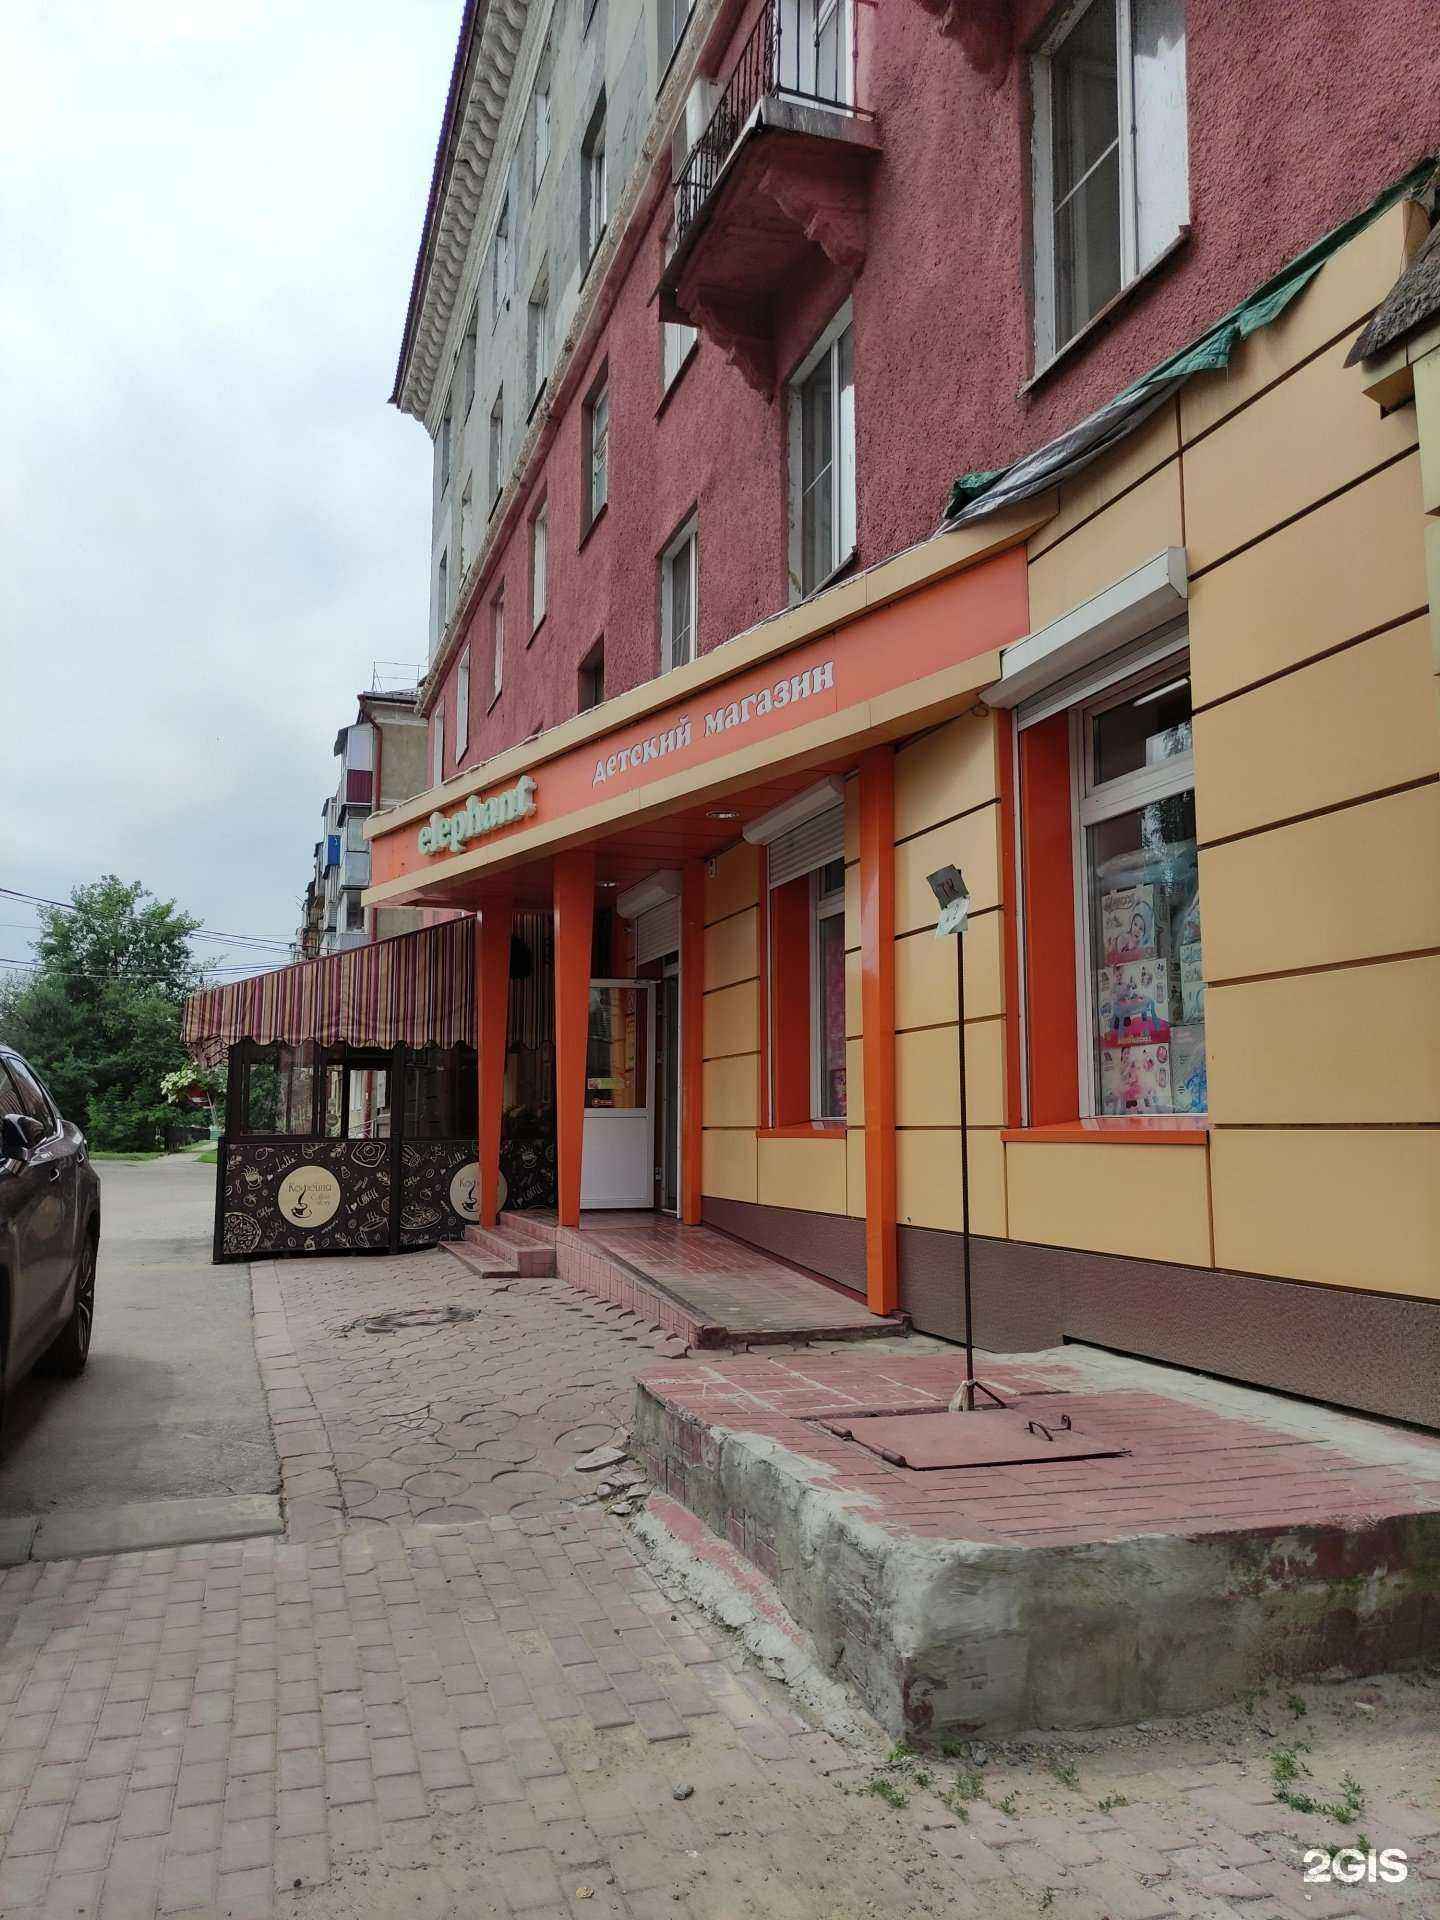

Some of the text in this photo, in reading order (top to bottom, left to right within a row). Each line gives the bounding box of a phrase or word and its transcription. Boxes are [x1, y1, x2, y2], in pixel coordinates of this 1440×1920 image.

[592, 660, 834, 790] детский магазин
[418, 775, 538, 855] elephant
